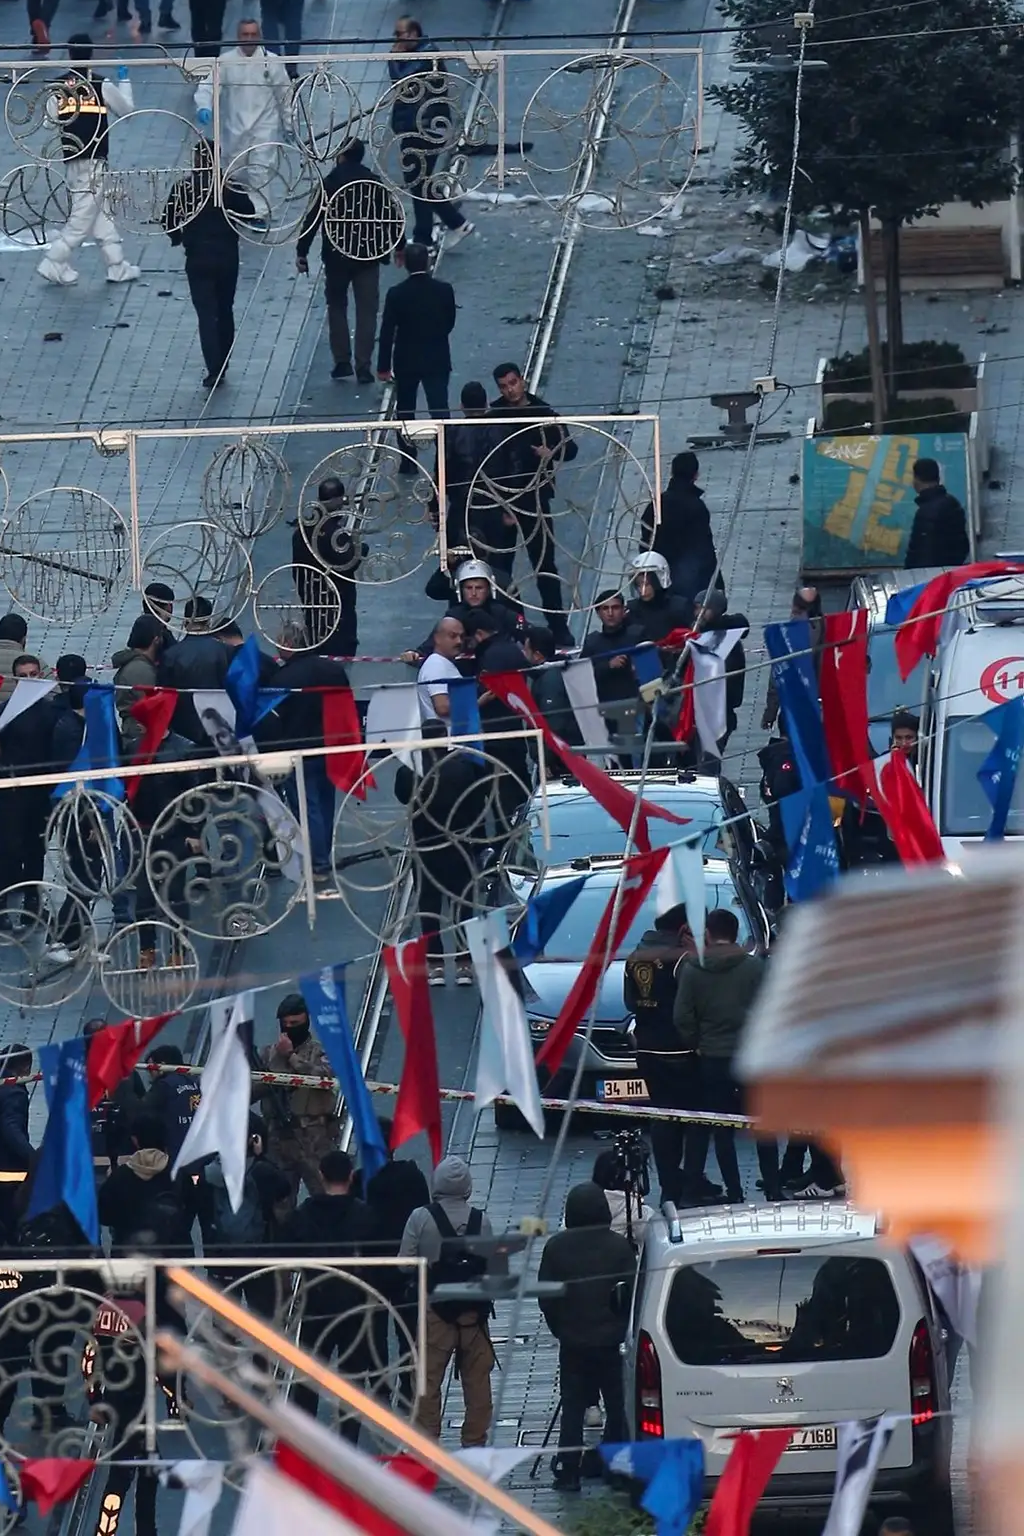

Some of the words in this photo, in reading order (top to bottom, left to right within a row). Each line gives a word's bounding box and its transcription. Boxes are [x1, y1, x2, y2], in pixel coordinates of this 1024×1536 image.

[605, 1082, 621, 1096] 34
[627, 1080, 643, 1096] HM
[801, 1428, 833, 1444] 7168
